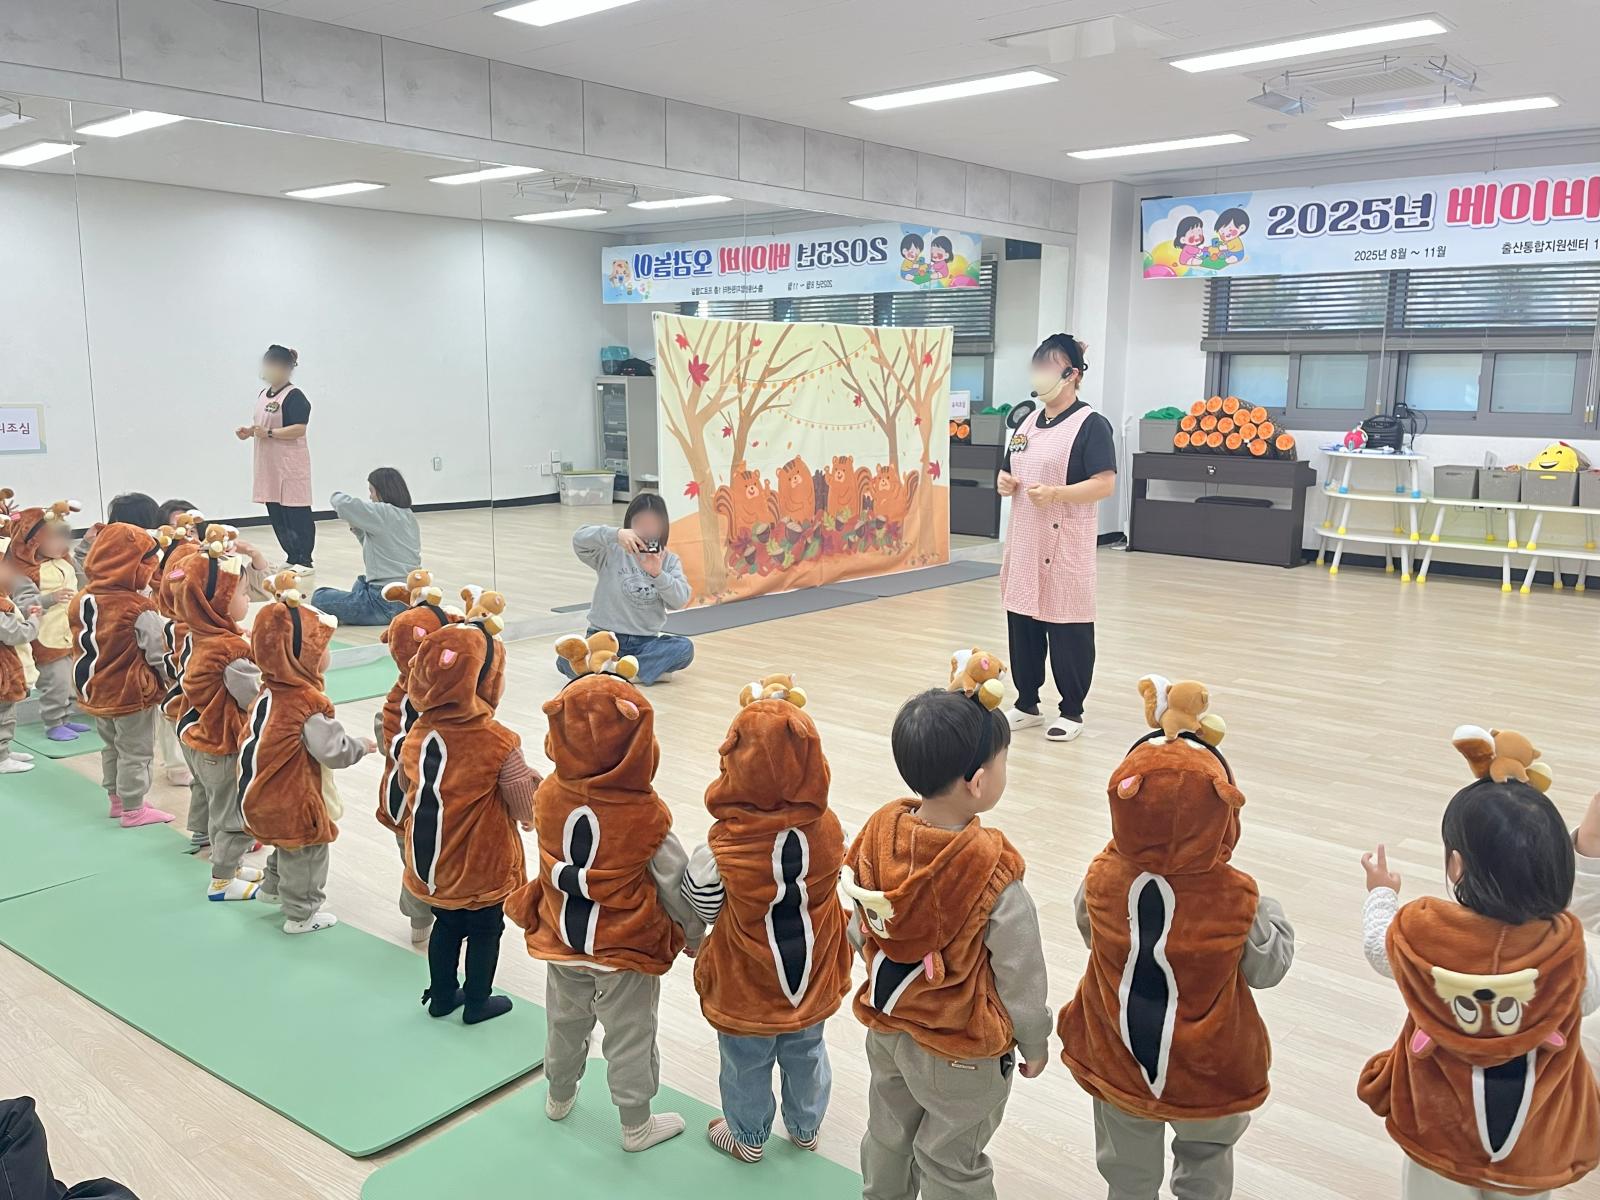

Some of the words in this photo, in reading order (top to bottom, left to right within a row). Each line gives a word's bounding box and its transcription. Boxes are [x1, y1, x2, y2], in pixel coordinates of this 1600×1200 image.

[1266, 192, 1434, 237] 2025년
[1354, 248, 1387, 261] 2025년
[1390, 247, 1407, 260] 8월
[1424, 245, 1447, 258] 11월
[1501, 237, 1589, 255] 출산통합지원센터
